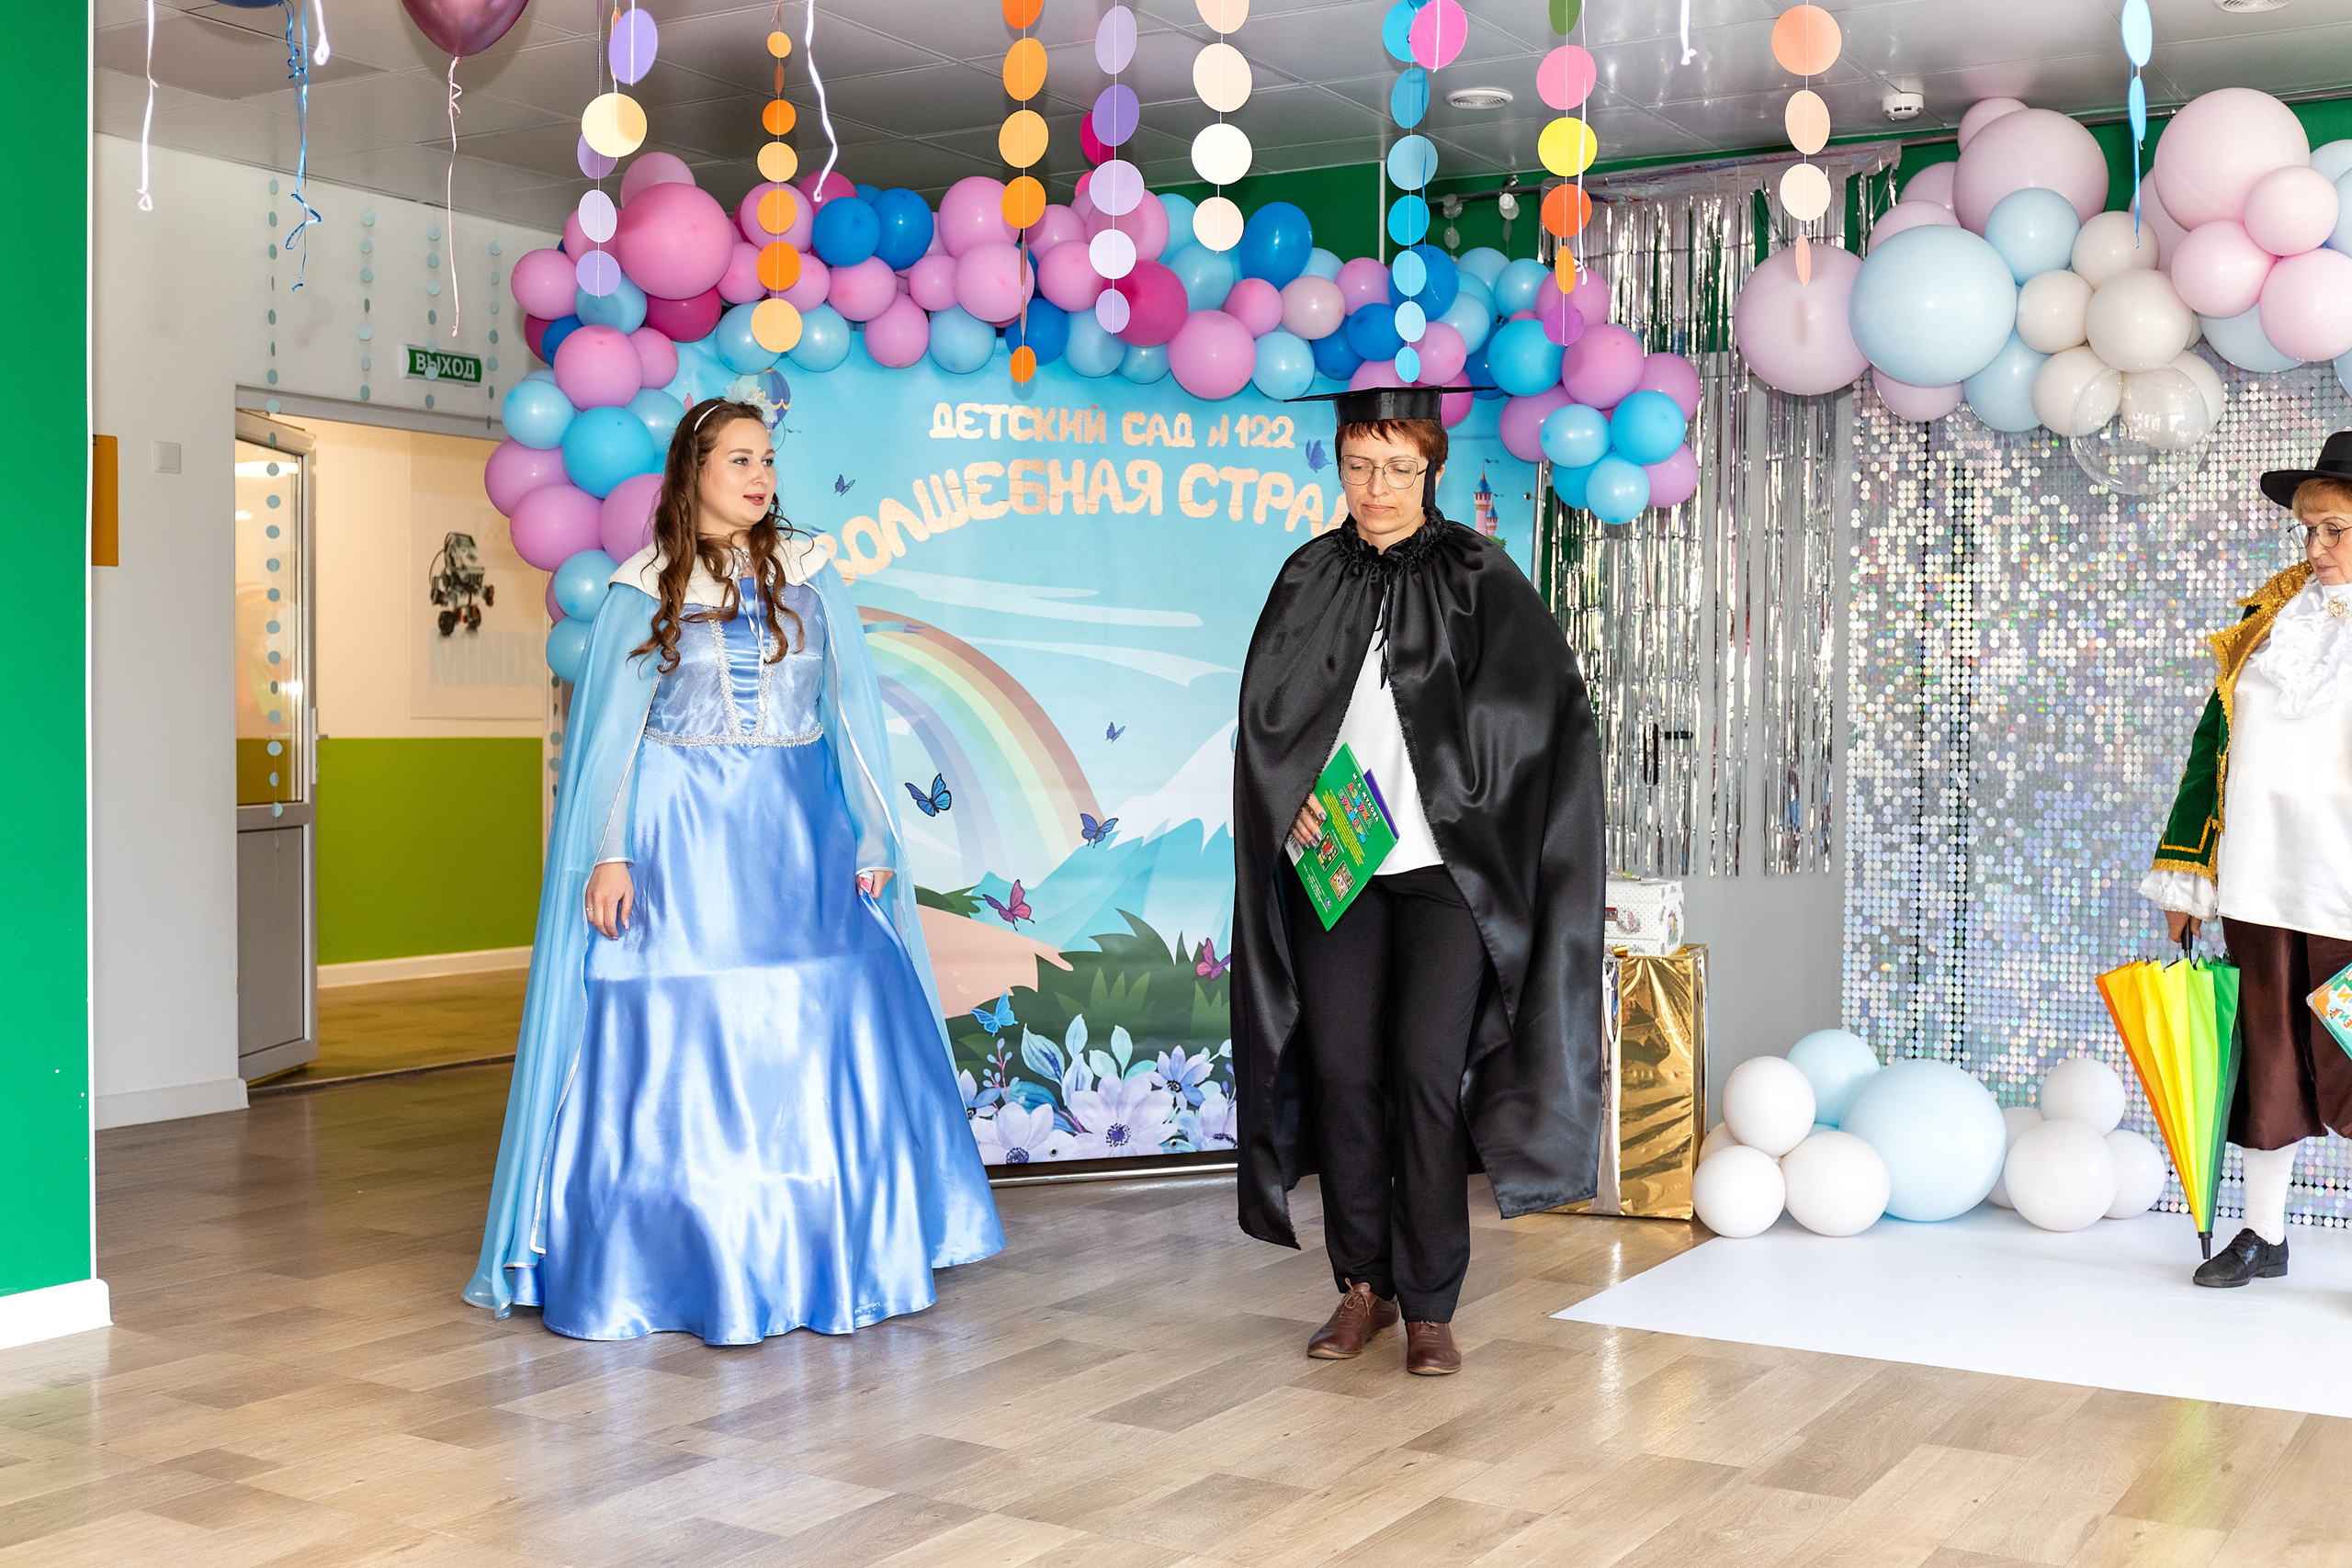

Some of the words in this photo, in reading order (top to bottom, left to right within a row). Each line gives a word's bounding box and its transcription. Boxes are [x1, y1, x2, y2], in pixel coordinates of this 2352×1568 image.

[415, 353, 475, 379] ВЫХОД
[929, 402, 1106, 444] ДЕТСКИЙ
[1122, 412, 1195, 448] САД
[1337, 788, 1366, 844] БУКВАРЬ
[1347, 783, 1373, 831] АЗБУКА
[1362, 790, 1379, 823] ЖУКОВА
